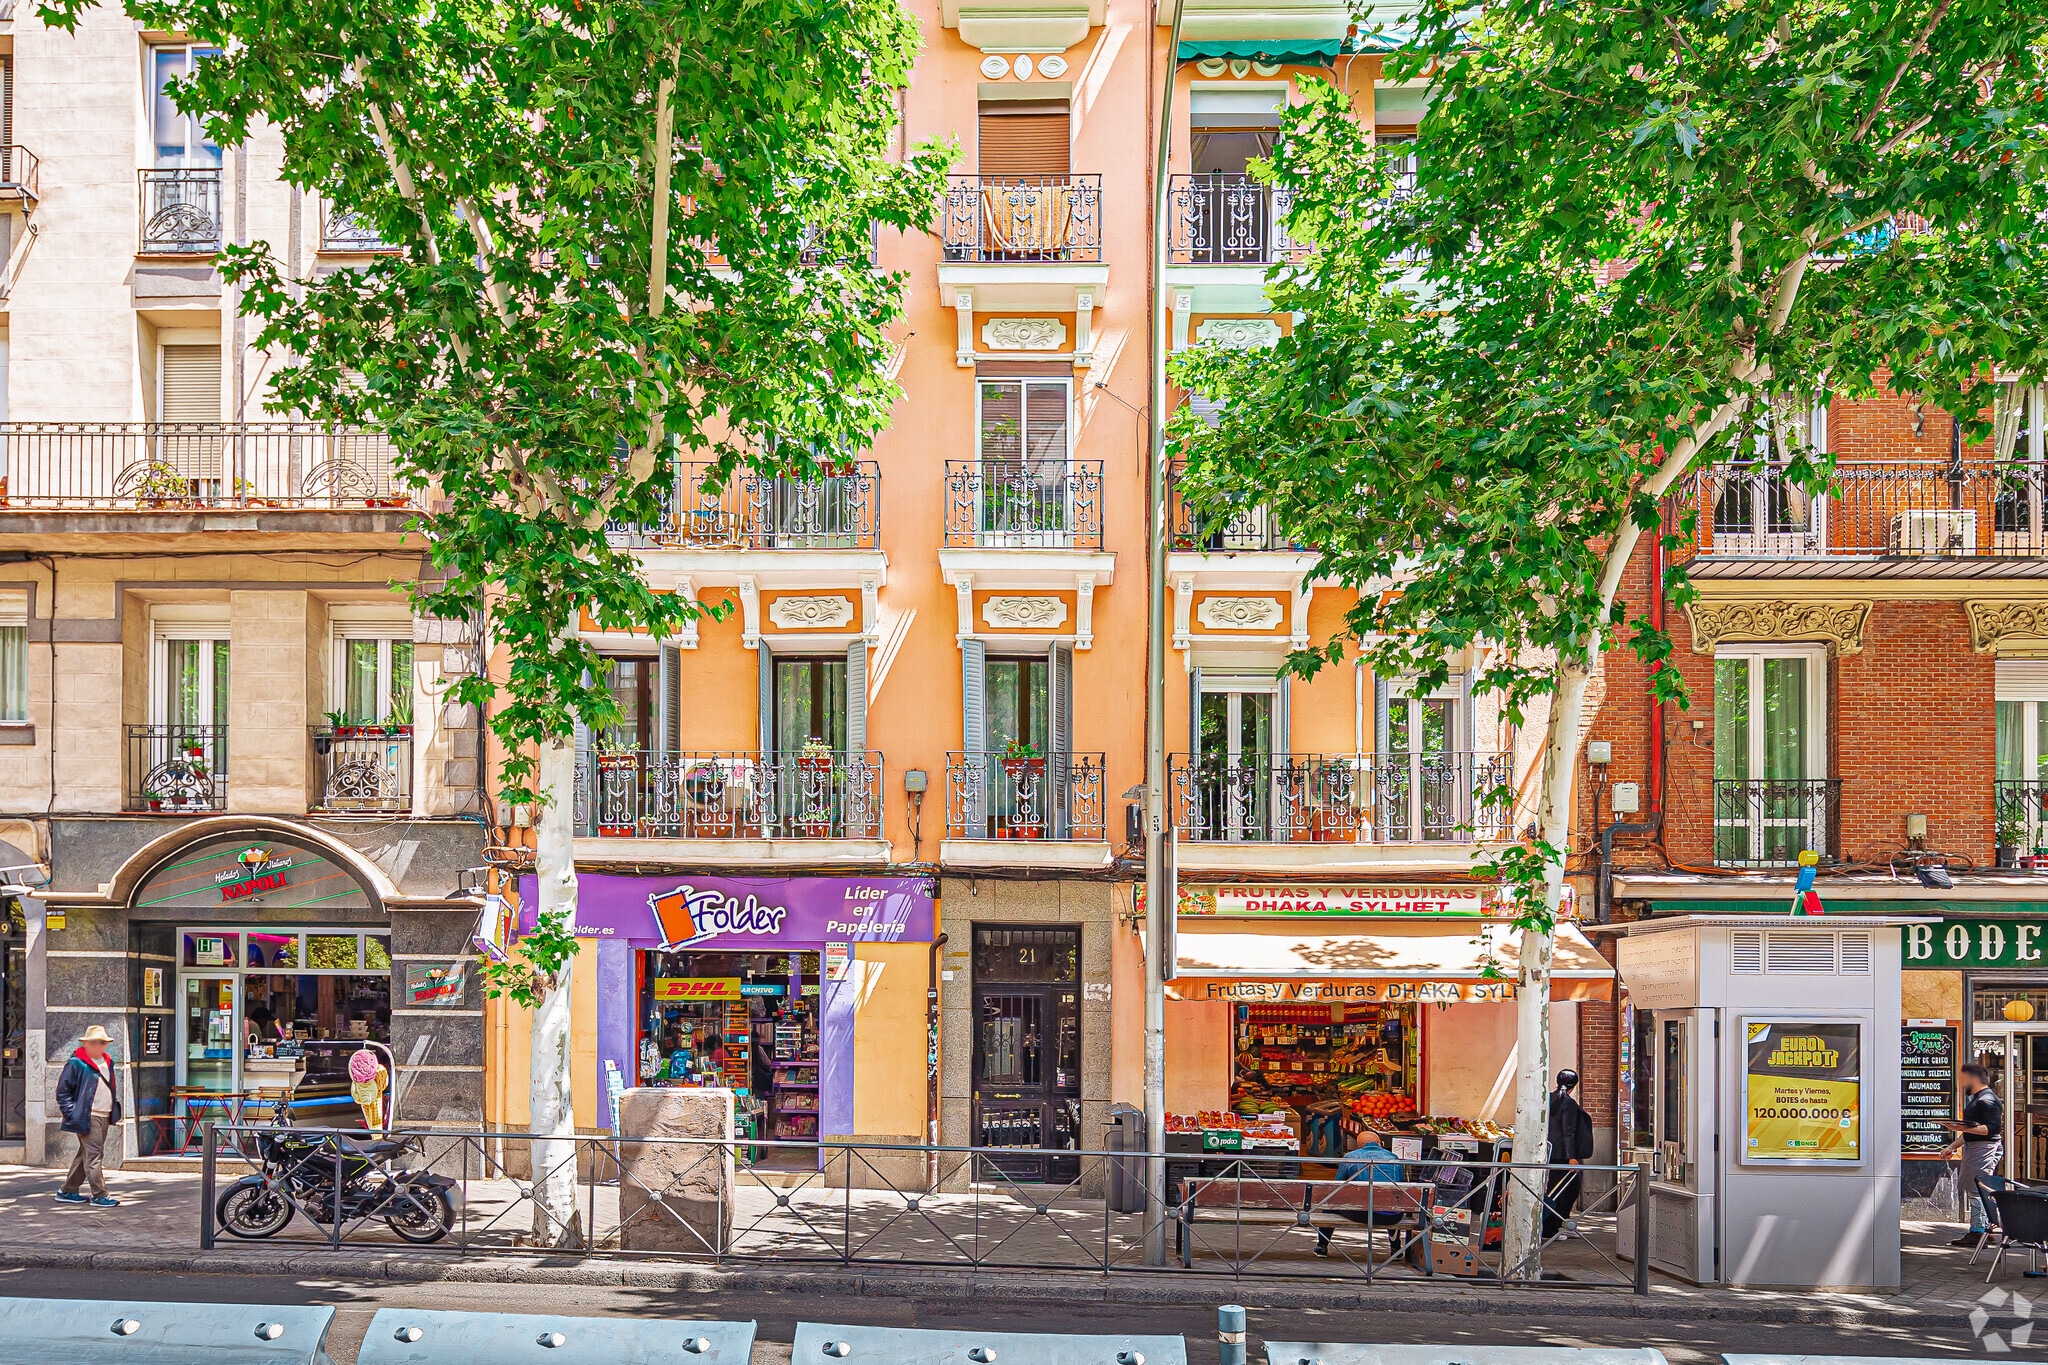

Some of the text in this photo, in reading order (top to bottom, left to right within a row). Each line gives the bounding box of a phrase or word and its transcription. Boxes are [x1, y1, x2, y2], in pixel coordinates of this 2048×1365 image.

[215, 857, 292, 883] Helados Italianos
[221, 871, 287, 902] NAPOLI
[844, 885, 888, 900] Líder
[1218, 887, 1310, 898] FRUTAS
[1317, 887, 1333, 898] Y
[680, 894, 783, 932] Folder
[852, 906, 874, 917] en
[1245, 901, 1328, 911] DHAKA
[826, 919, 906, 936] Papelería
[200, 939, 211, 952] H
[1907, 924, 2041, 961] BODE
[1019, 948, 1036, 963] 21
[414, 983, 456, 1001] NAPOLI
[666, 982, 731, 996] DHL
[1206, 982, 1267, 998] Frutas
[1271, 983, 1282, 999] y
[1289, 983, 1377, 998] Verduras
[1388, 983, 1460, 998] DHAKA
[1781, 1036, 1819, 1051] EURO
[1767, 1051, 1833, 1067] JACKPOT
[1922, 1056, 1930, 1064] DE
[1931, 1056, 1949, 1065] GRIFO
[1928, 1069, 1951, 1077] SELECTAS
[1804, 1087, 1831, 1095] Viernes,
[1908, 1082, 1941, 1090] AHUMADOS
[1776, 1096, 1799, 1104] BOTES
[1907, 1095, 1942, 1103] ENCURTIDOS
[1905, 1133, 1942, 1143] ZAMBURIÑAS
